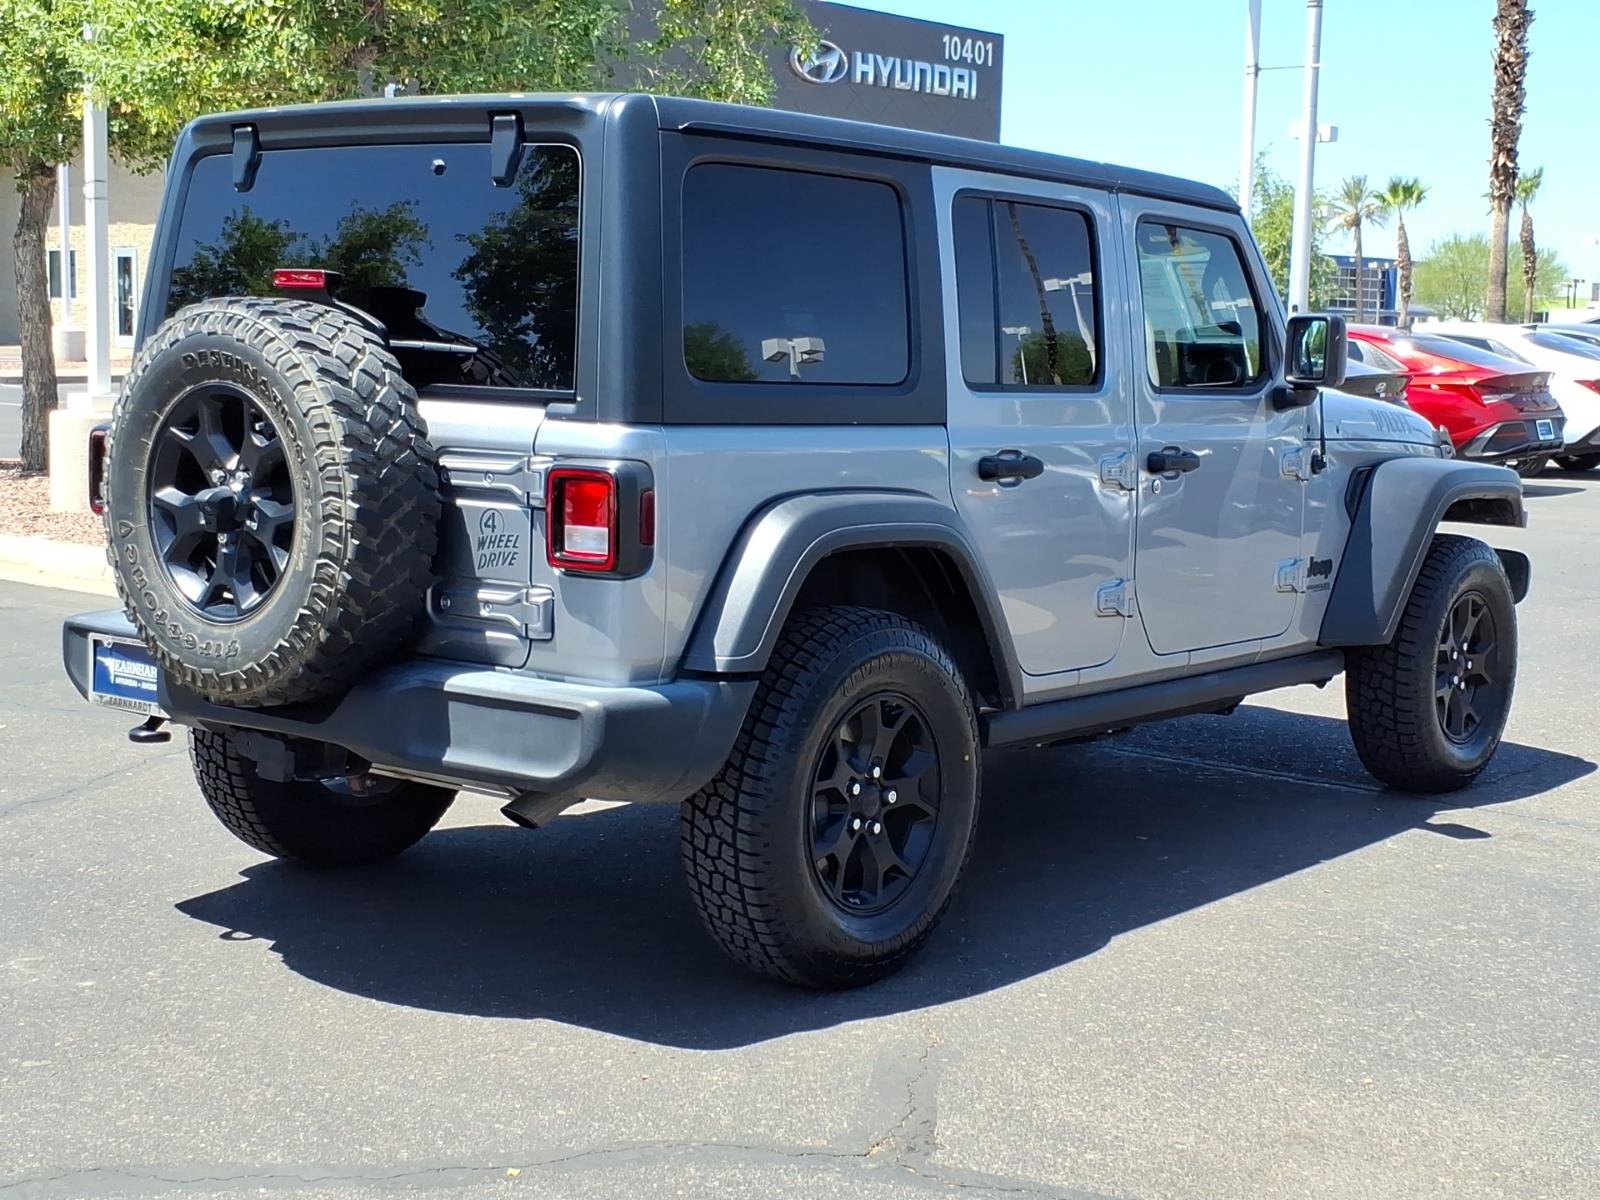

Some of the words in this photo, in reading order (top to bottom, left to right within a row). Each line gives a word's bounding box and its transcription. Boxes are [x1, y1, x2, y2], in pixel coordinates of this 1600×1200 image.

[942, 34, 993, 67] 10401
[852, 51, 978, 100] HYUNDAI
[181, 348, 306, 466] DESTINATION
[483, 512, 497, 534] 4
[476, 533, 520, 553] WHEEL
[477, 550, 519, 570] DRIVE
[1306, 556, 1333, 579] Jeep
[109, 696, 152, 713] EARNHARDT
